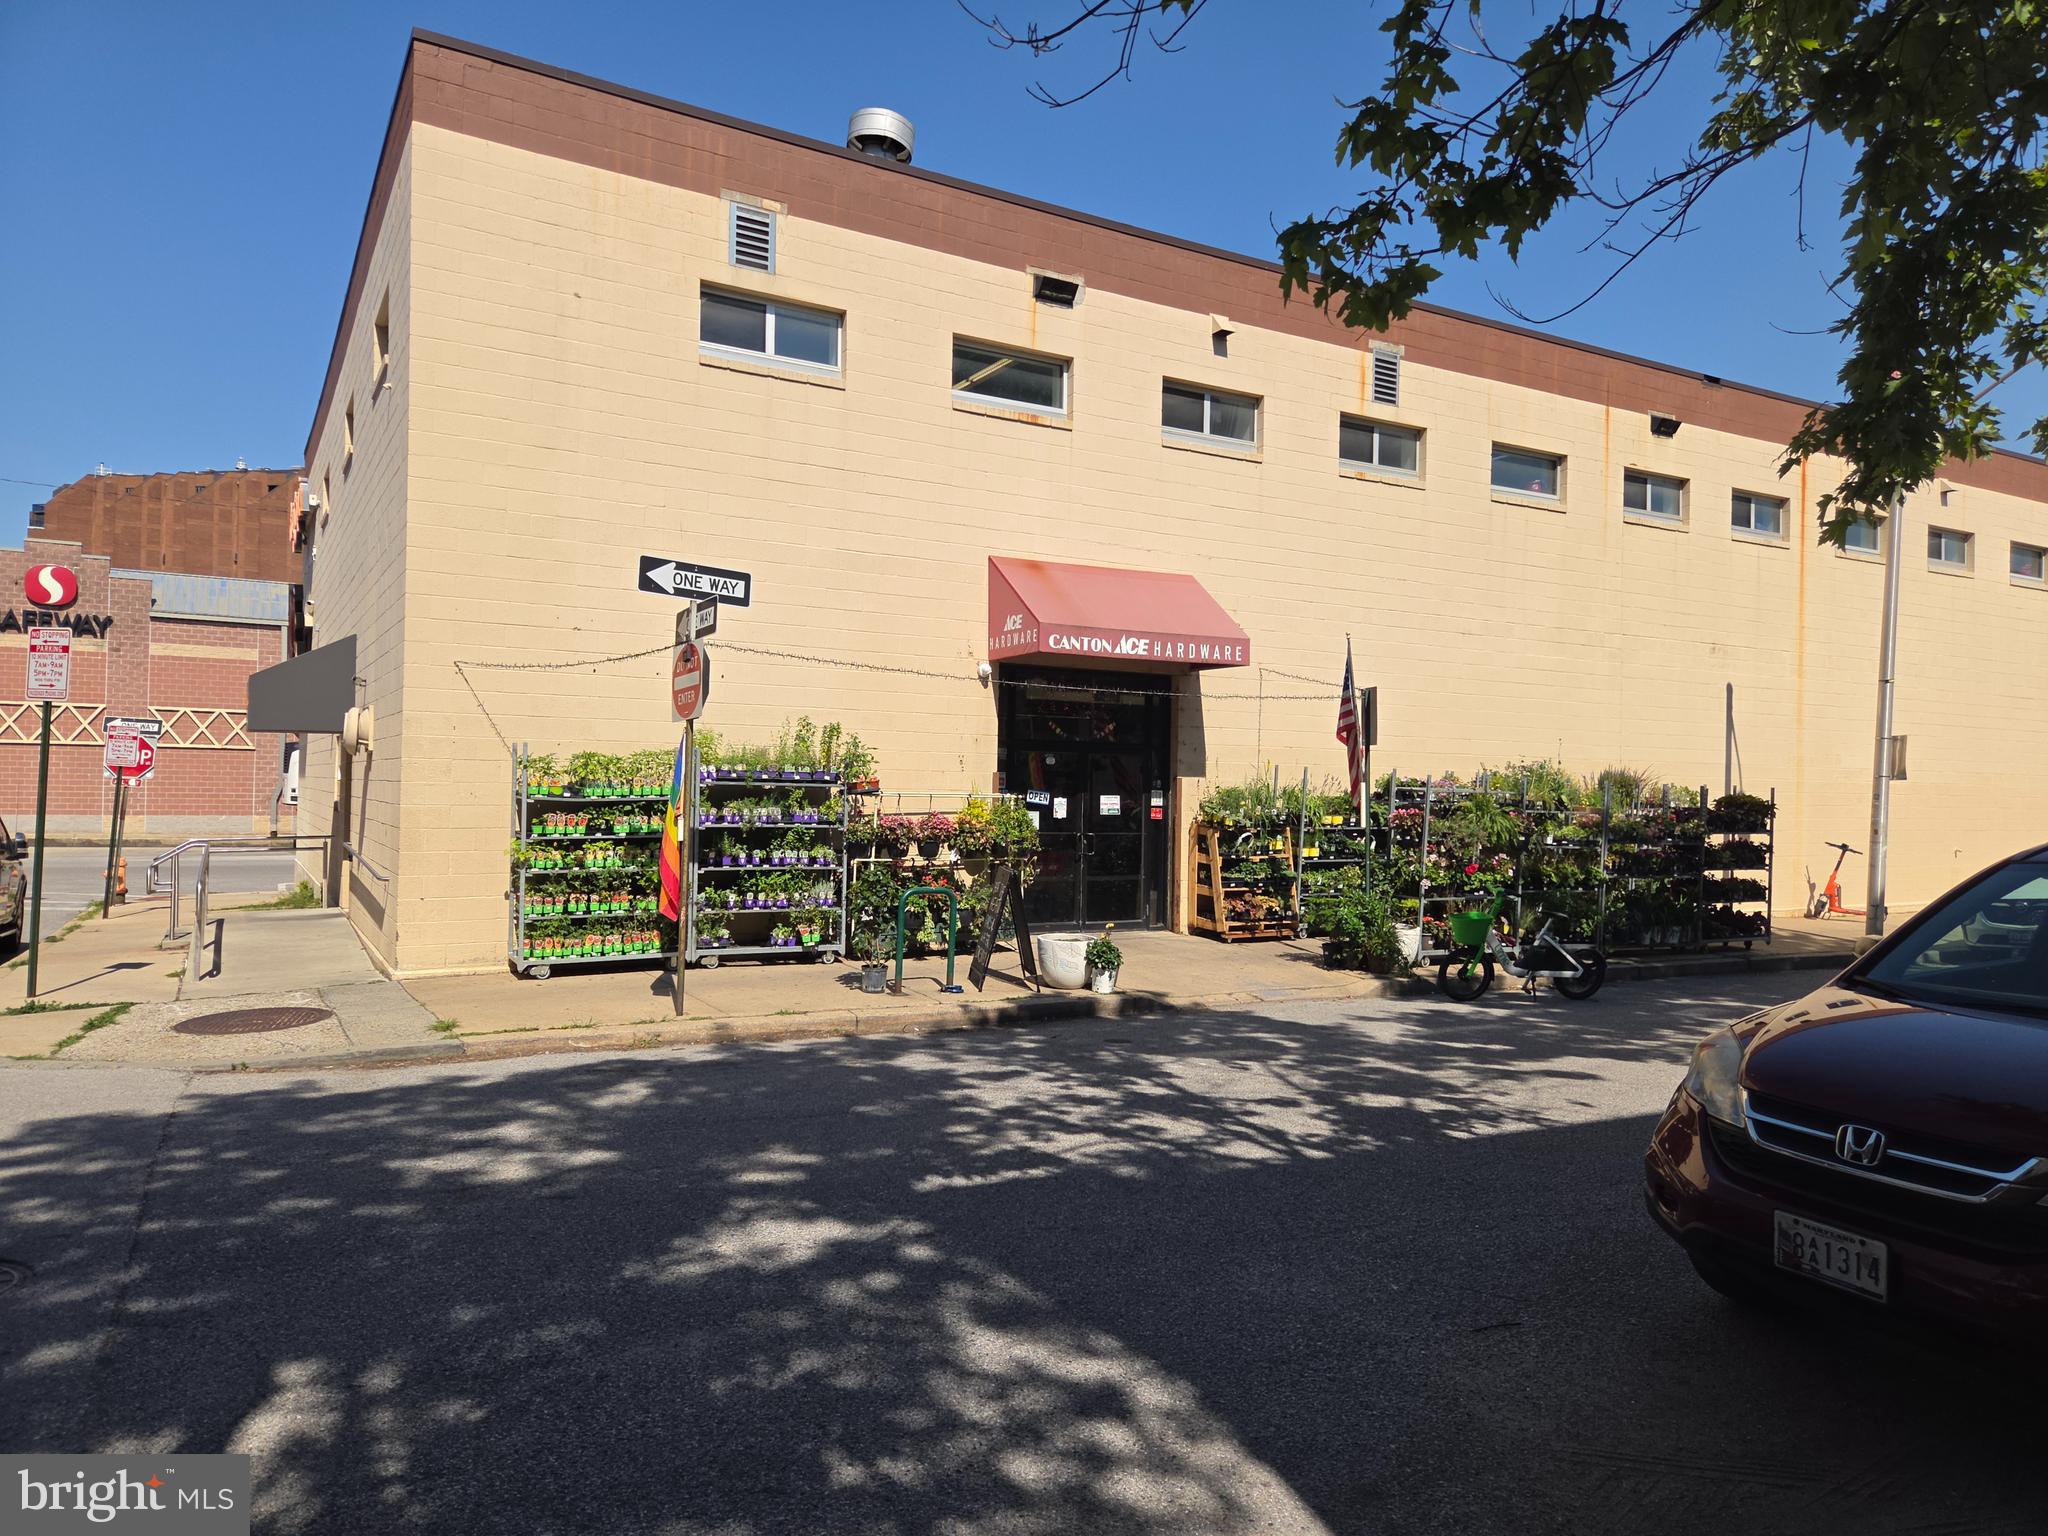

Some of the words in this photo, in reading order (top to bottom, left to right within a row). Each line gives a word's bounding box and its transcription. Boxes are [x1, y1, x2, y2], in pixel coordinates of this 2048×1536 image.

[673, 572, 703, 590] ONE
[709, 578, 739, 595] WAY
[699, 610, 713, 626] WAY
[1003, 614, 1023, 632] ACE
[989, 629, 1038, 650] HARDWARE
[1048, 634, 1112, 652] CANTON
[1114, 633, 1149, 655] ACE
[1154, 641, 1242, 661] HARDWARE
[36, 645, 62, 653] PARKING
[678, 690, 696, 705] ENTER
[1028, 791, 1048, 803] OPEN
